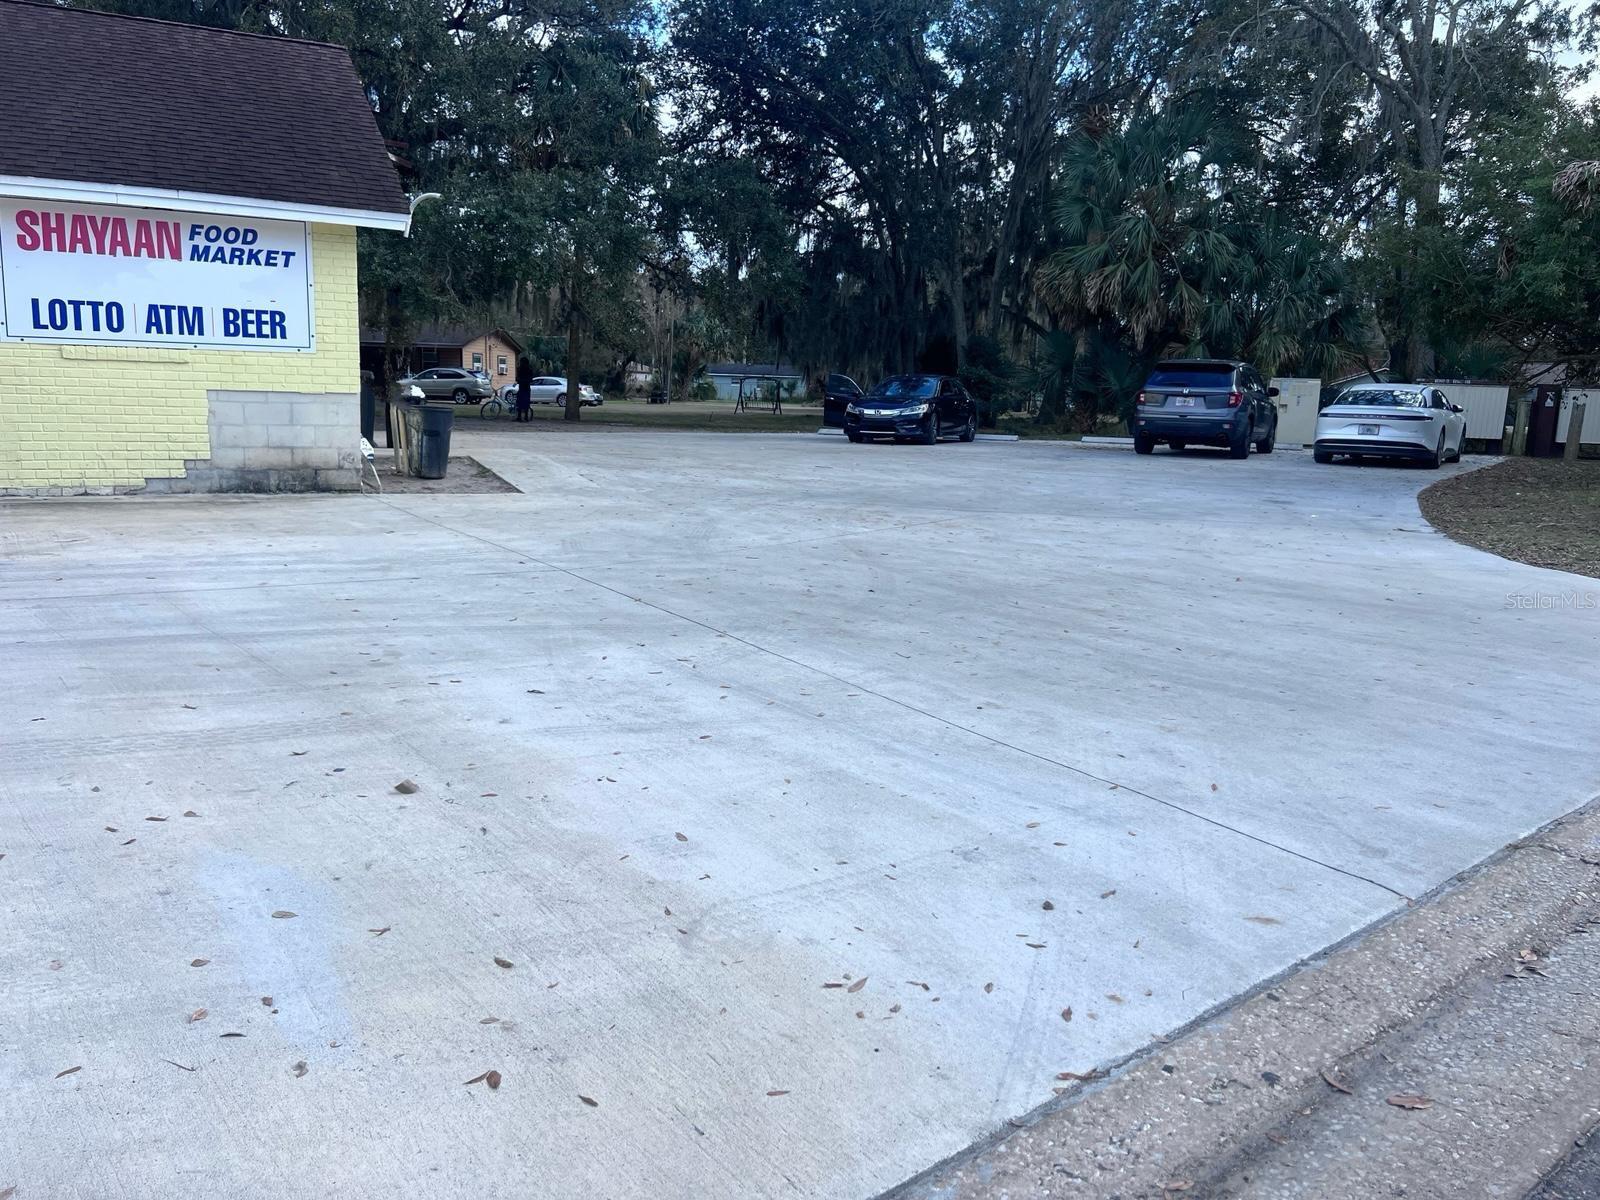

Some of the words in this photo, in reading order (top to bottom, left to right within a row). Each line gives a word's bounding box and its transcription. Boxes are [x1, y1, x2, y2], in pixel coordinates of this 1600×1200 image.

[15, 209, 182, 261] SHAYAAN
[188, 224, 259, 246] FOOD
[189, 244, 297, 268] MARKET
[31, 298, 125, 333] LOTTO
[145, 303, 205, 337] ATM
[222, 308, 288, 340] BEER
